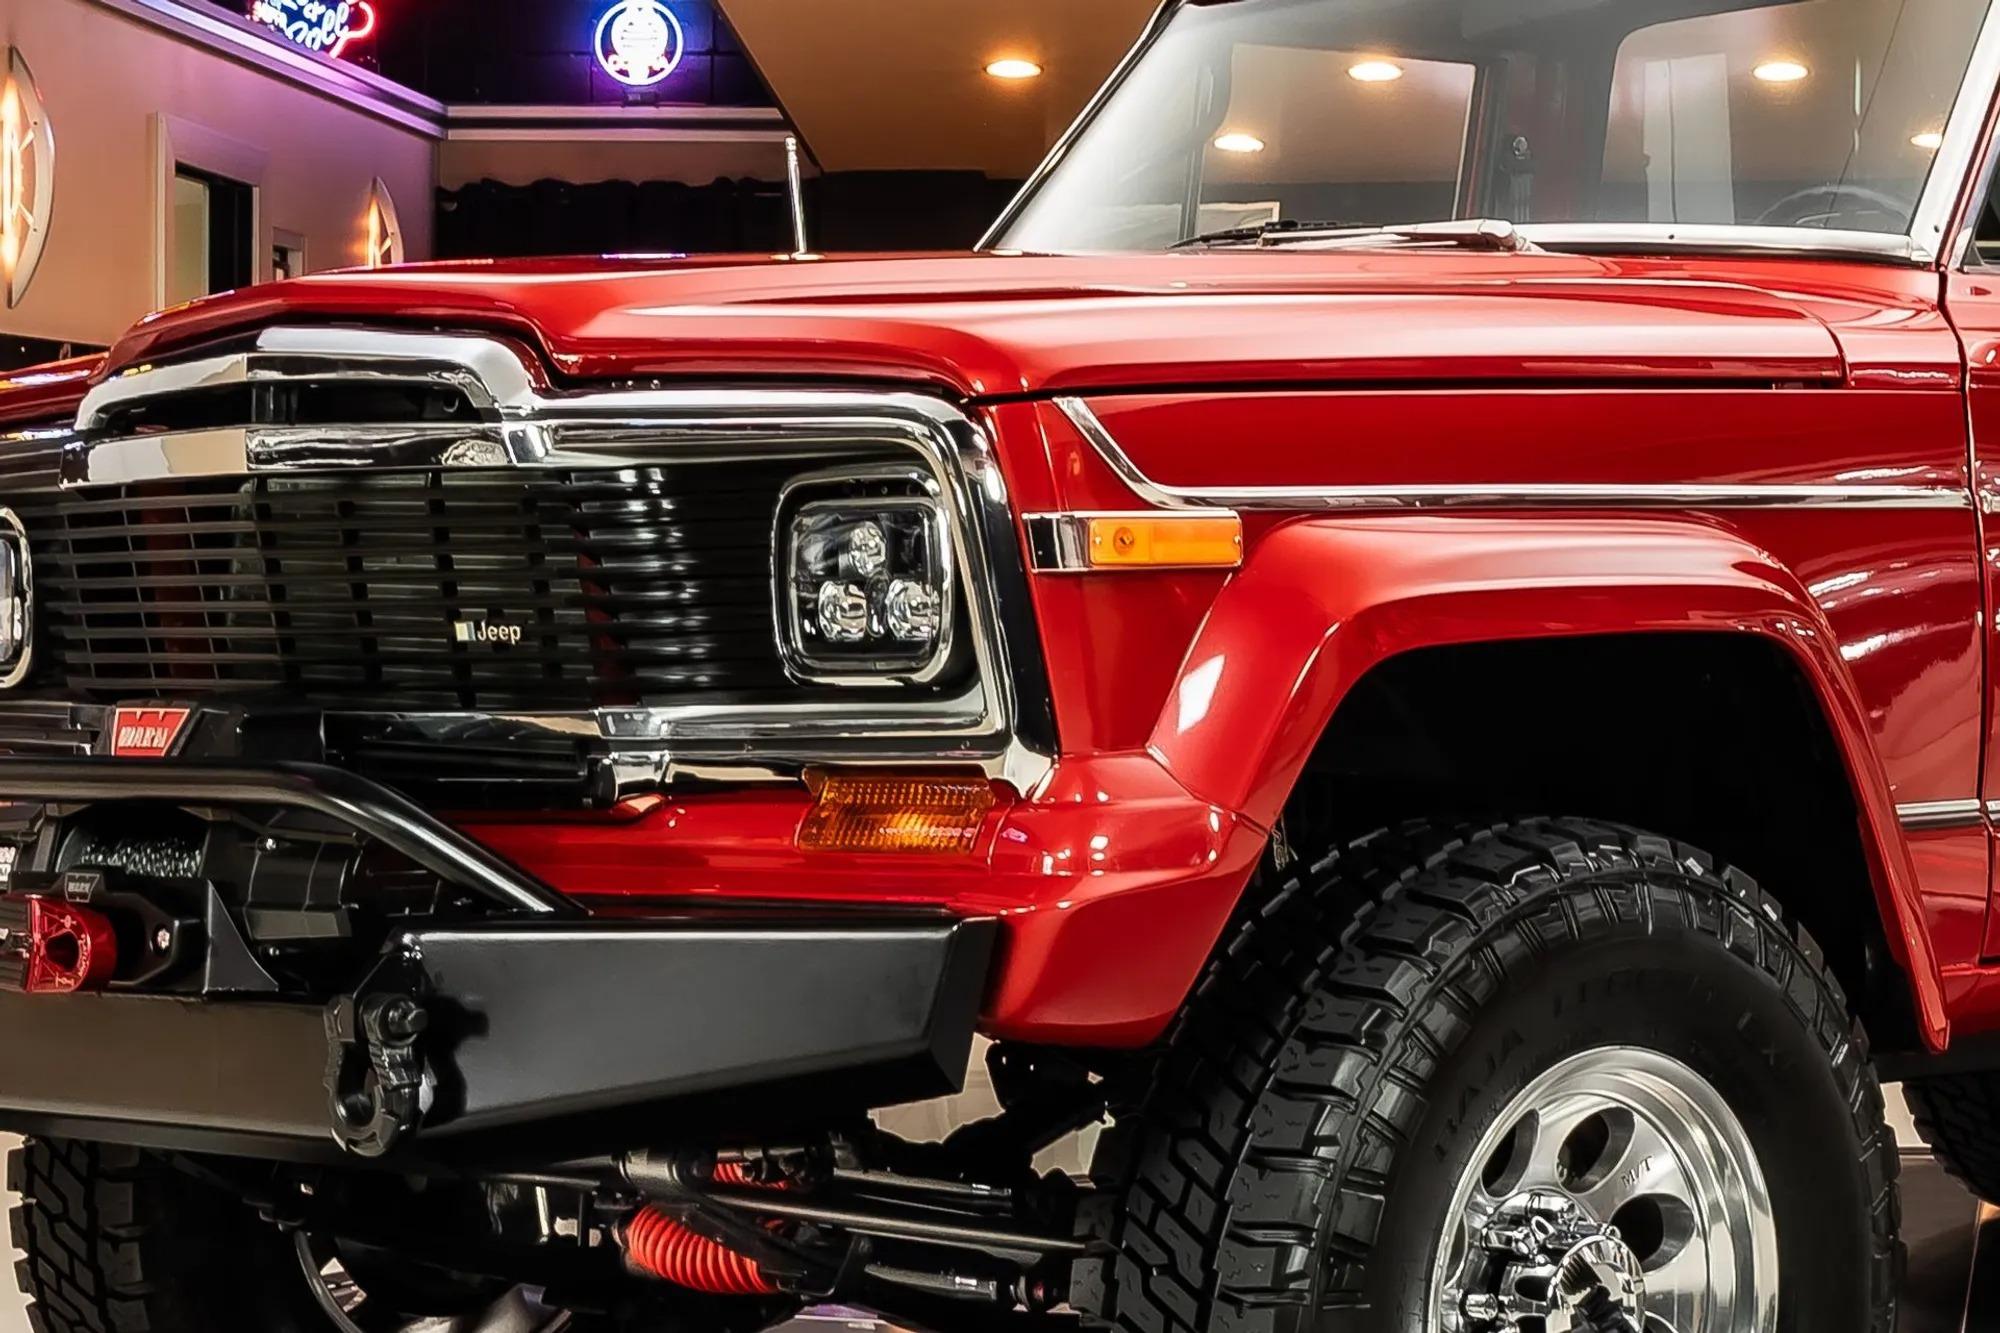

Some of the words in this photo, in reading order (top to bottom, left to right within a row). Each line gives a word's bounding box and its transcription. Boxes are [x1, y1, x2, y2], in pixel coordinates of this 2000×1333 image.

[477, 619, 521, 645] Jeep
[118, 726, 170, 748] WARN
[1620, 1154, 1654, 1189] M/T
